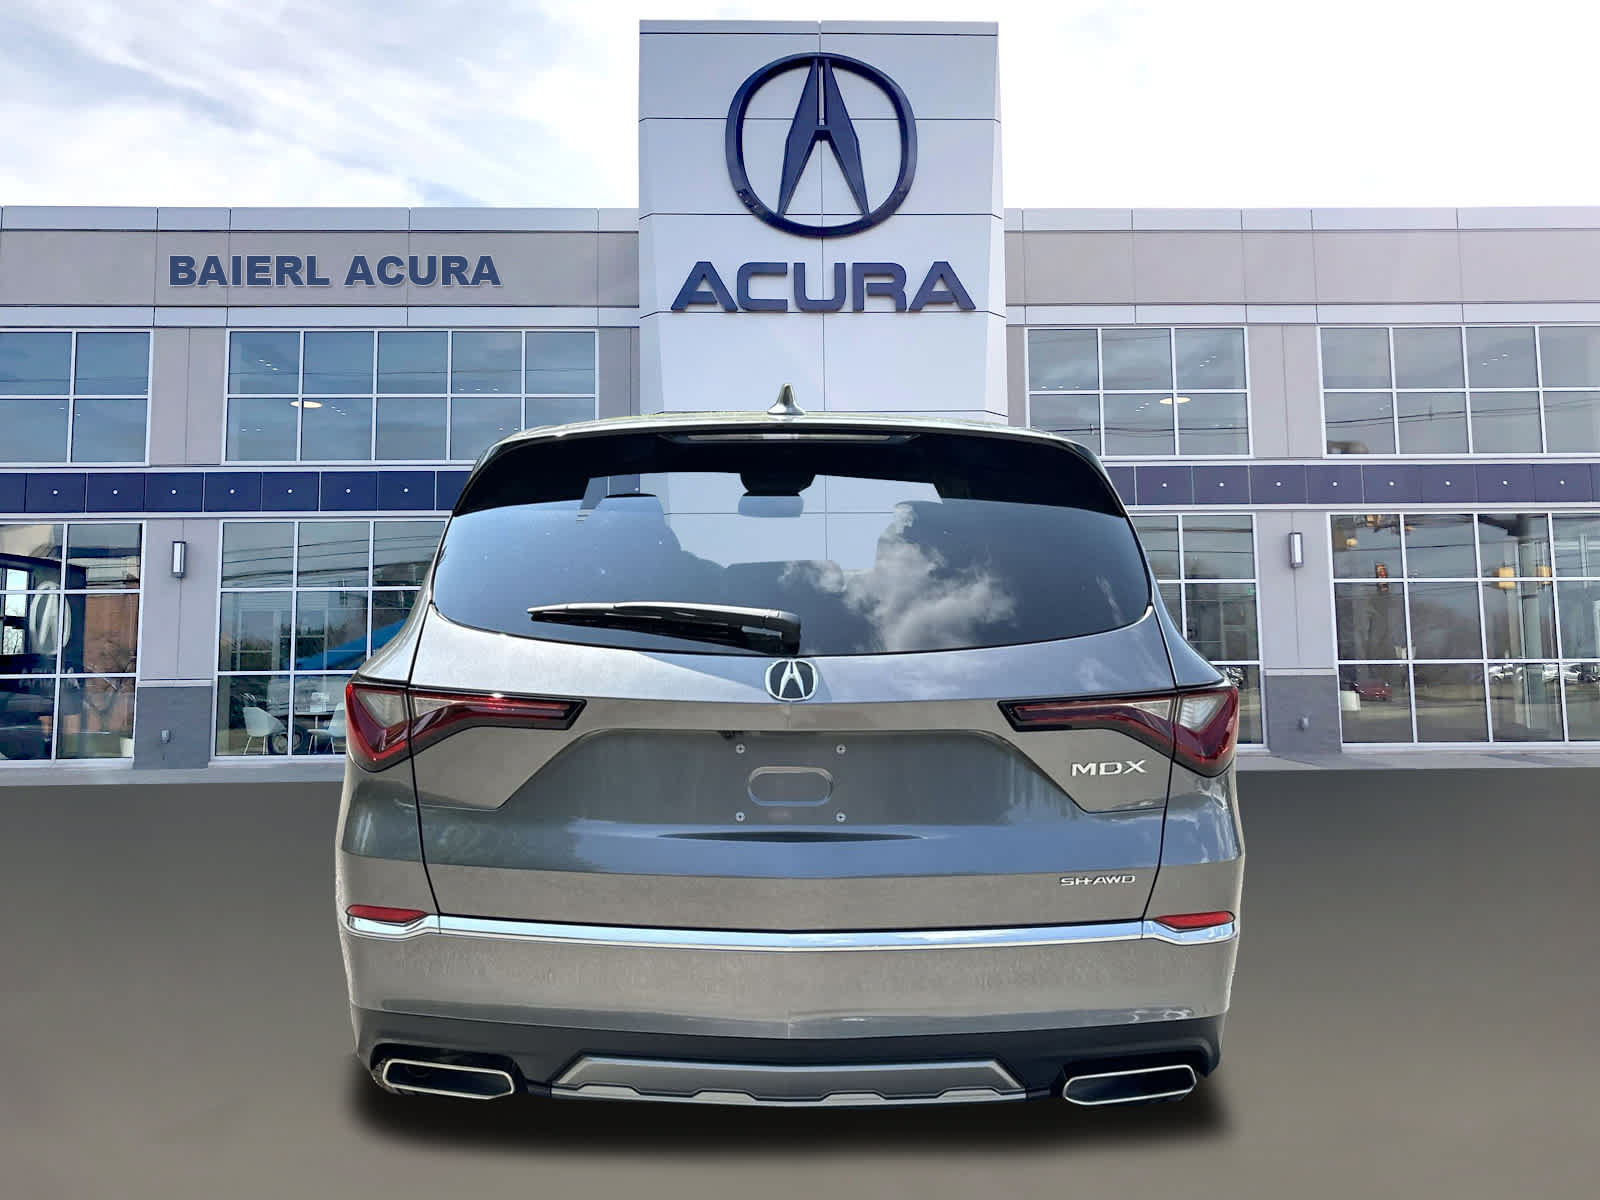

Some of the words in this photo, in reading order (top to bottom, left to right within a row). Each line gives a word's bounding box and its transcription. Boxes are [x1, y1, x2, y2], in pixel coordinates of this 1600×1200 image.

[168, 255, 331, 287] BAIERL
[345, 255, 503, 287] ACURA
[671, 261, 976, 313] ACURA
[1071, 759, 1147, 777] MDX
